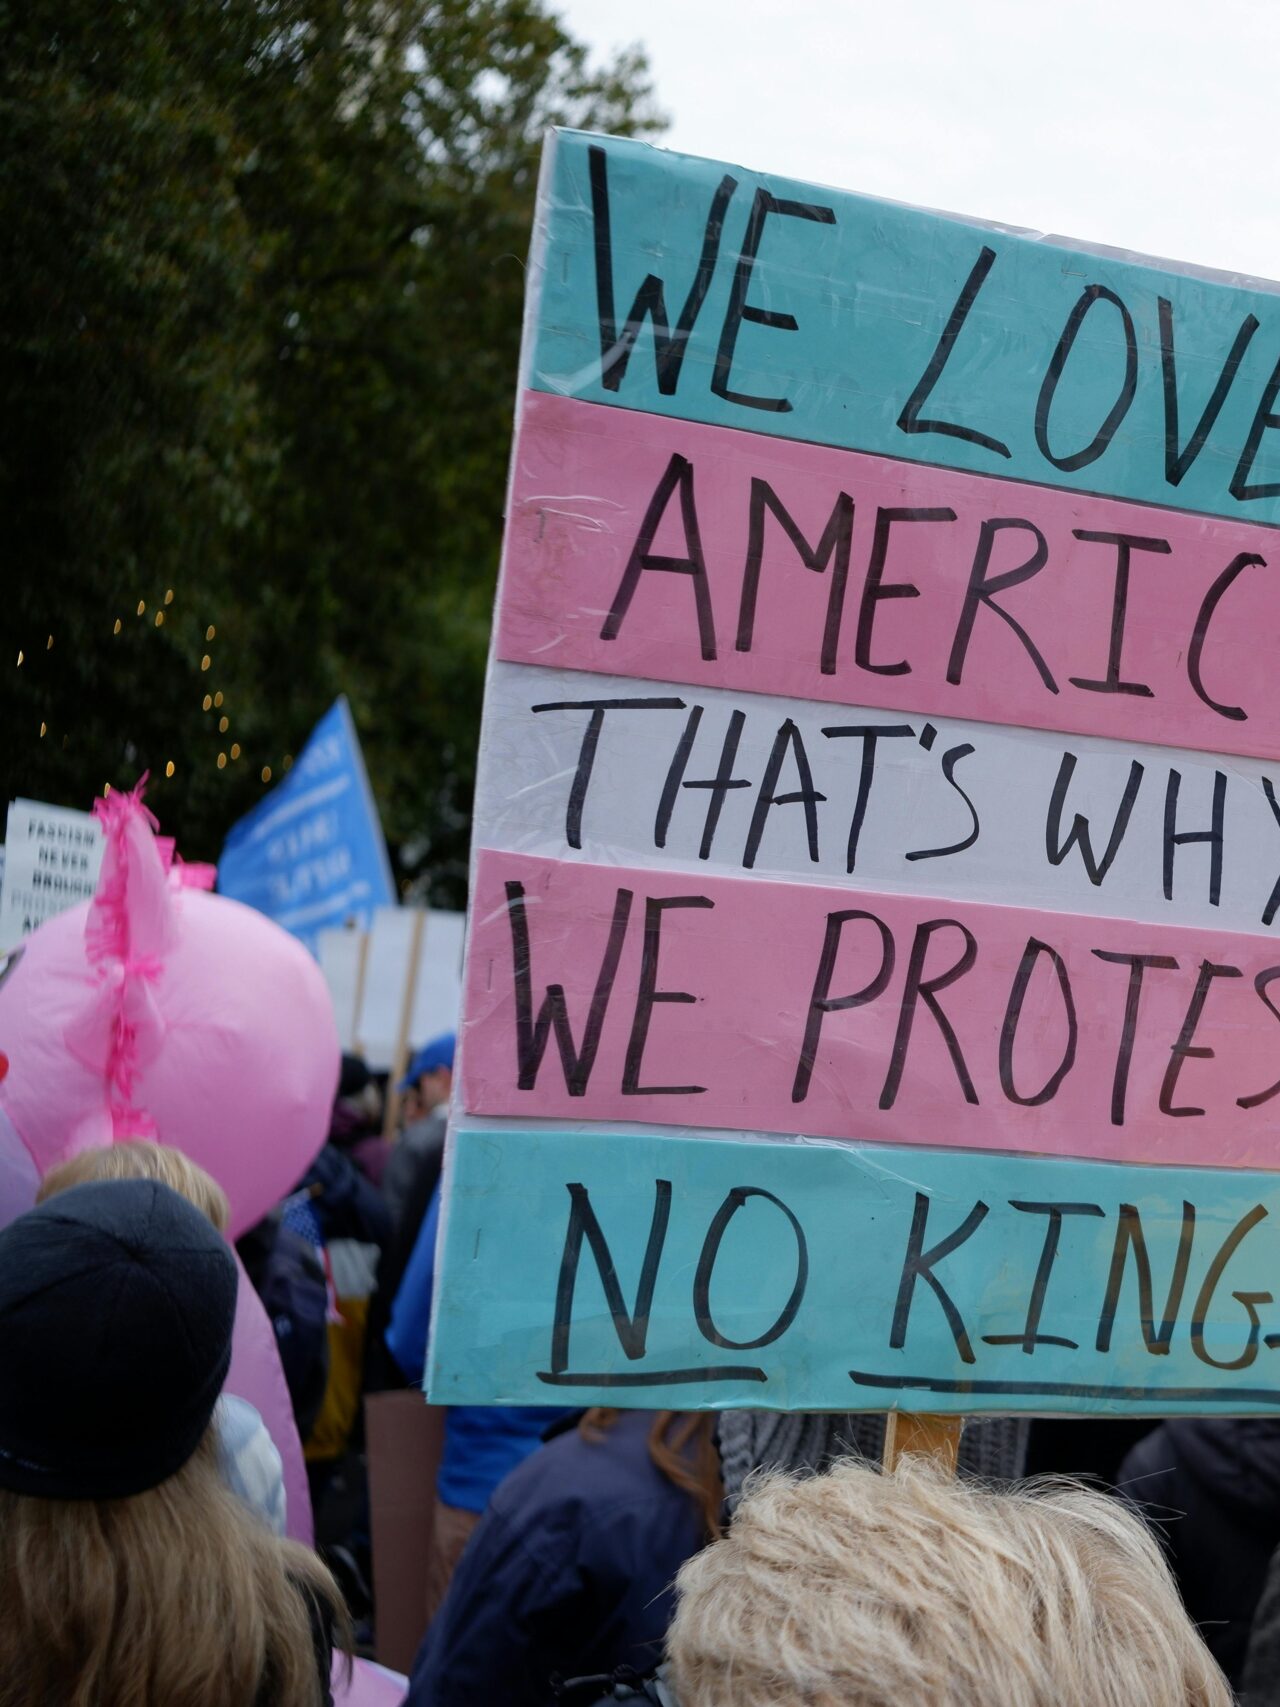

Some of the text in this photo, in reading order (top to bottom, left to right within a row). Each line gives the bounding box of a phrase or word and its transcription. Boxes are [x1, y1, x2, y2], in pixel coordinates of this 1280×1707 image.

[588, 144, 838, 414] WE
[39, 845, 88, 871] NEVER
[530, 696, 980, 874] THAT’S
[504, 880, 716, 1097] WE
[549, 1178, 809, 1374] NO
